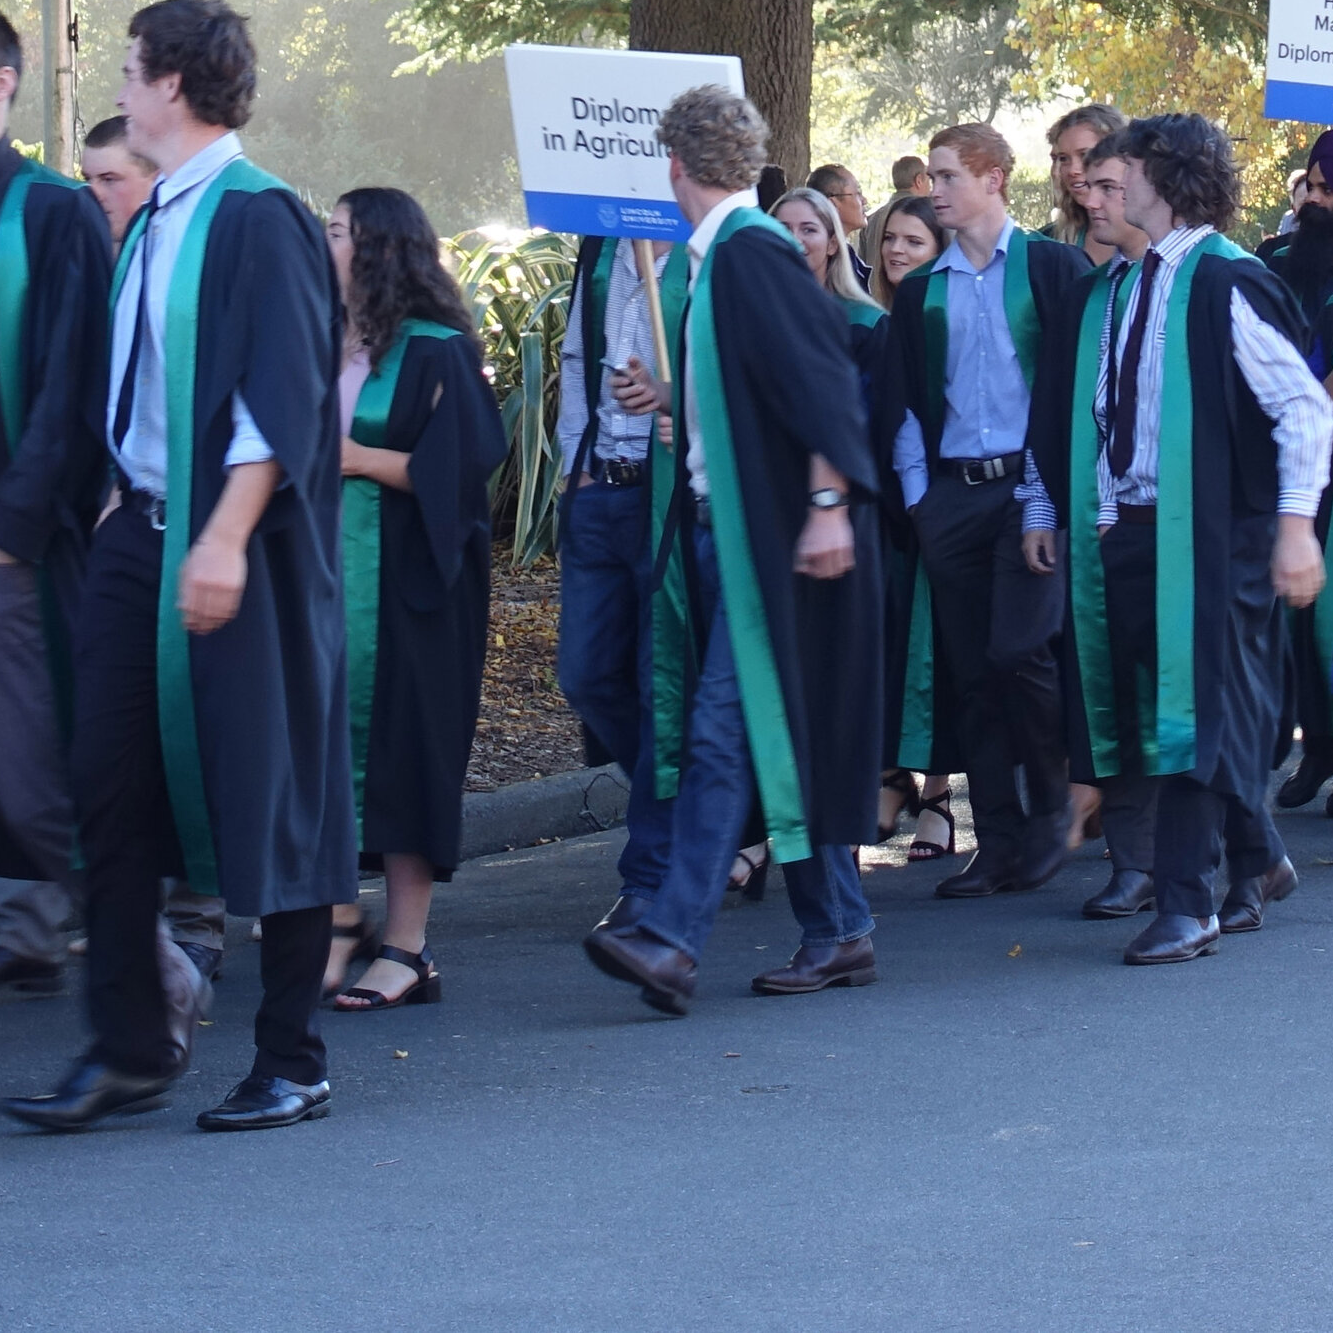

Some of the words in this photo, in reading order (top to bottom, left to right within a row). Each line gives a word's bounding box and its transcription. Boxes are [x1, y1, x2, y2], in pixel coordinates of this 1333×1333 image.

[571, 96, 661, 127] Diplom
[541, 126, 566, 151] in
[573, 129, 672, 159] Agricul
